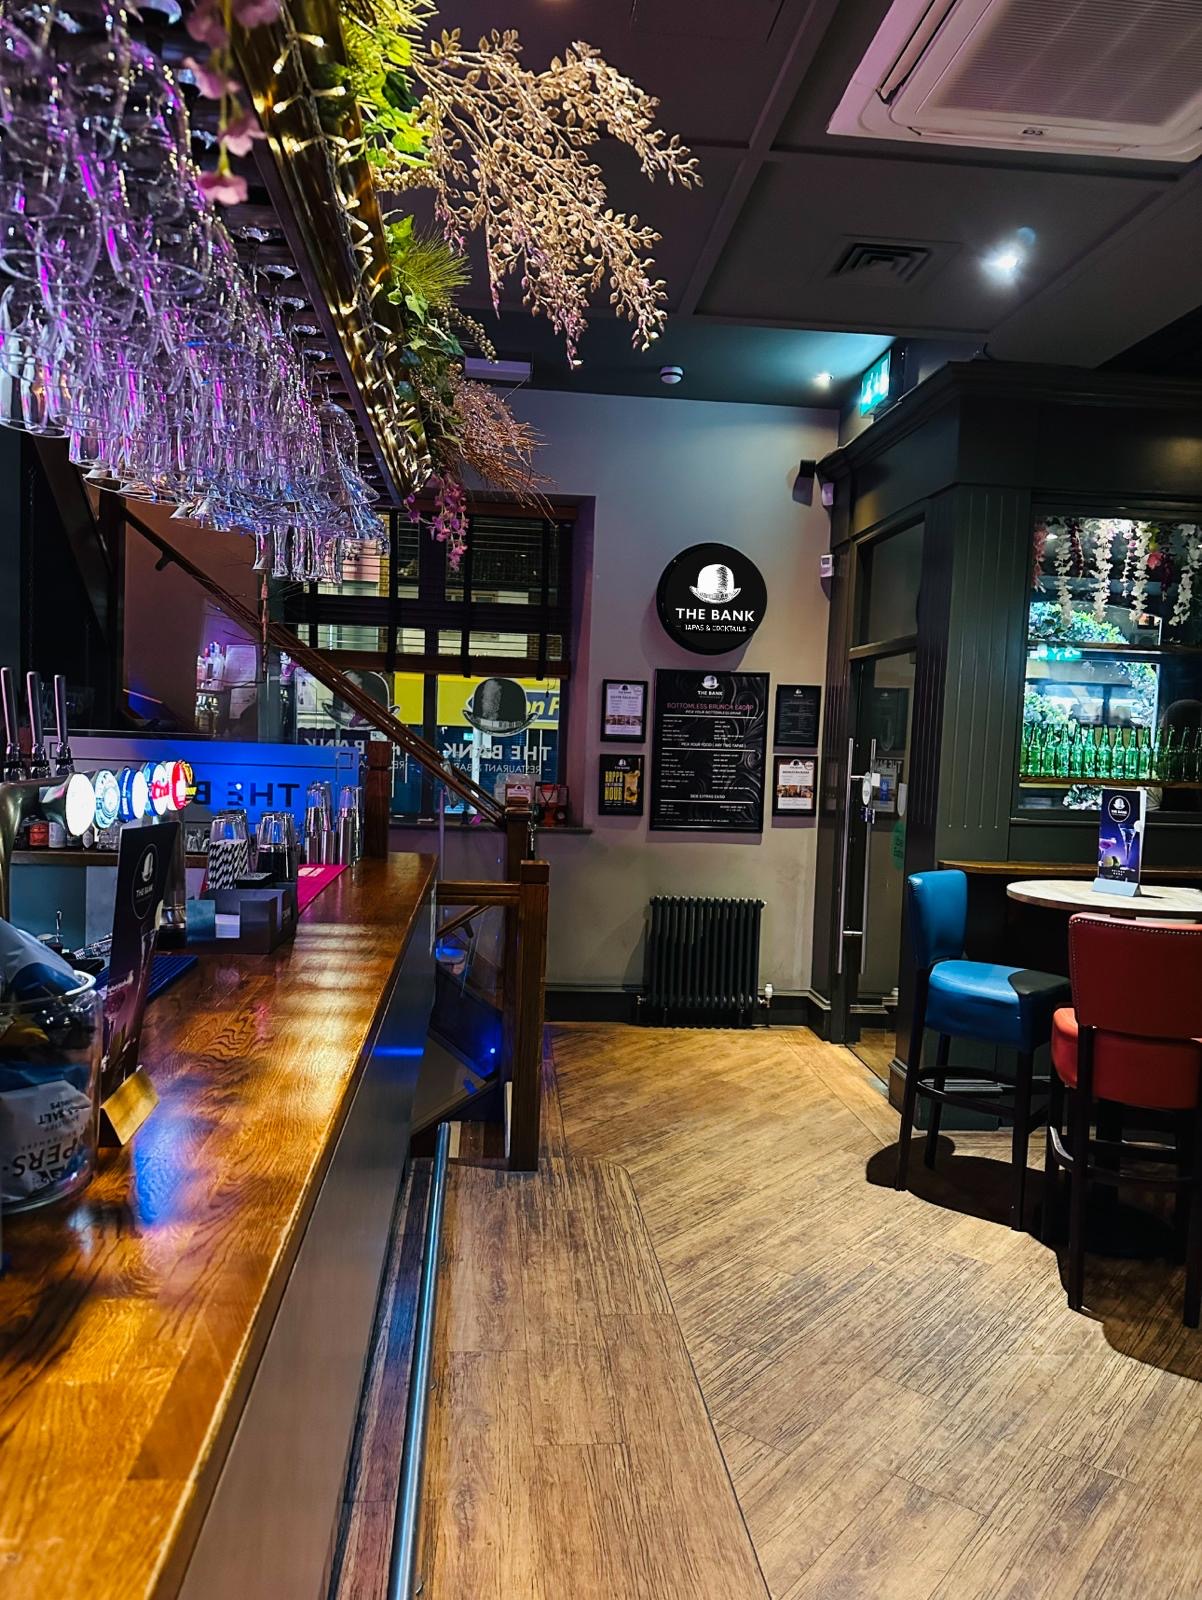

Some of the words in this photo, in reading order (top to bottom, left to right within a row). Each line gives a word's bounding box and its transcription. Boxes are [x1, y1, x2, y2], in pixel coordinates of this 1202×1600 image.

[675, 607, 706, 620] THE
[711, 609, 755, 622] BANK
[666, 702, 708, 710] BOTTOMLESS
[12, 1138, 79, 1178] PERS
